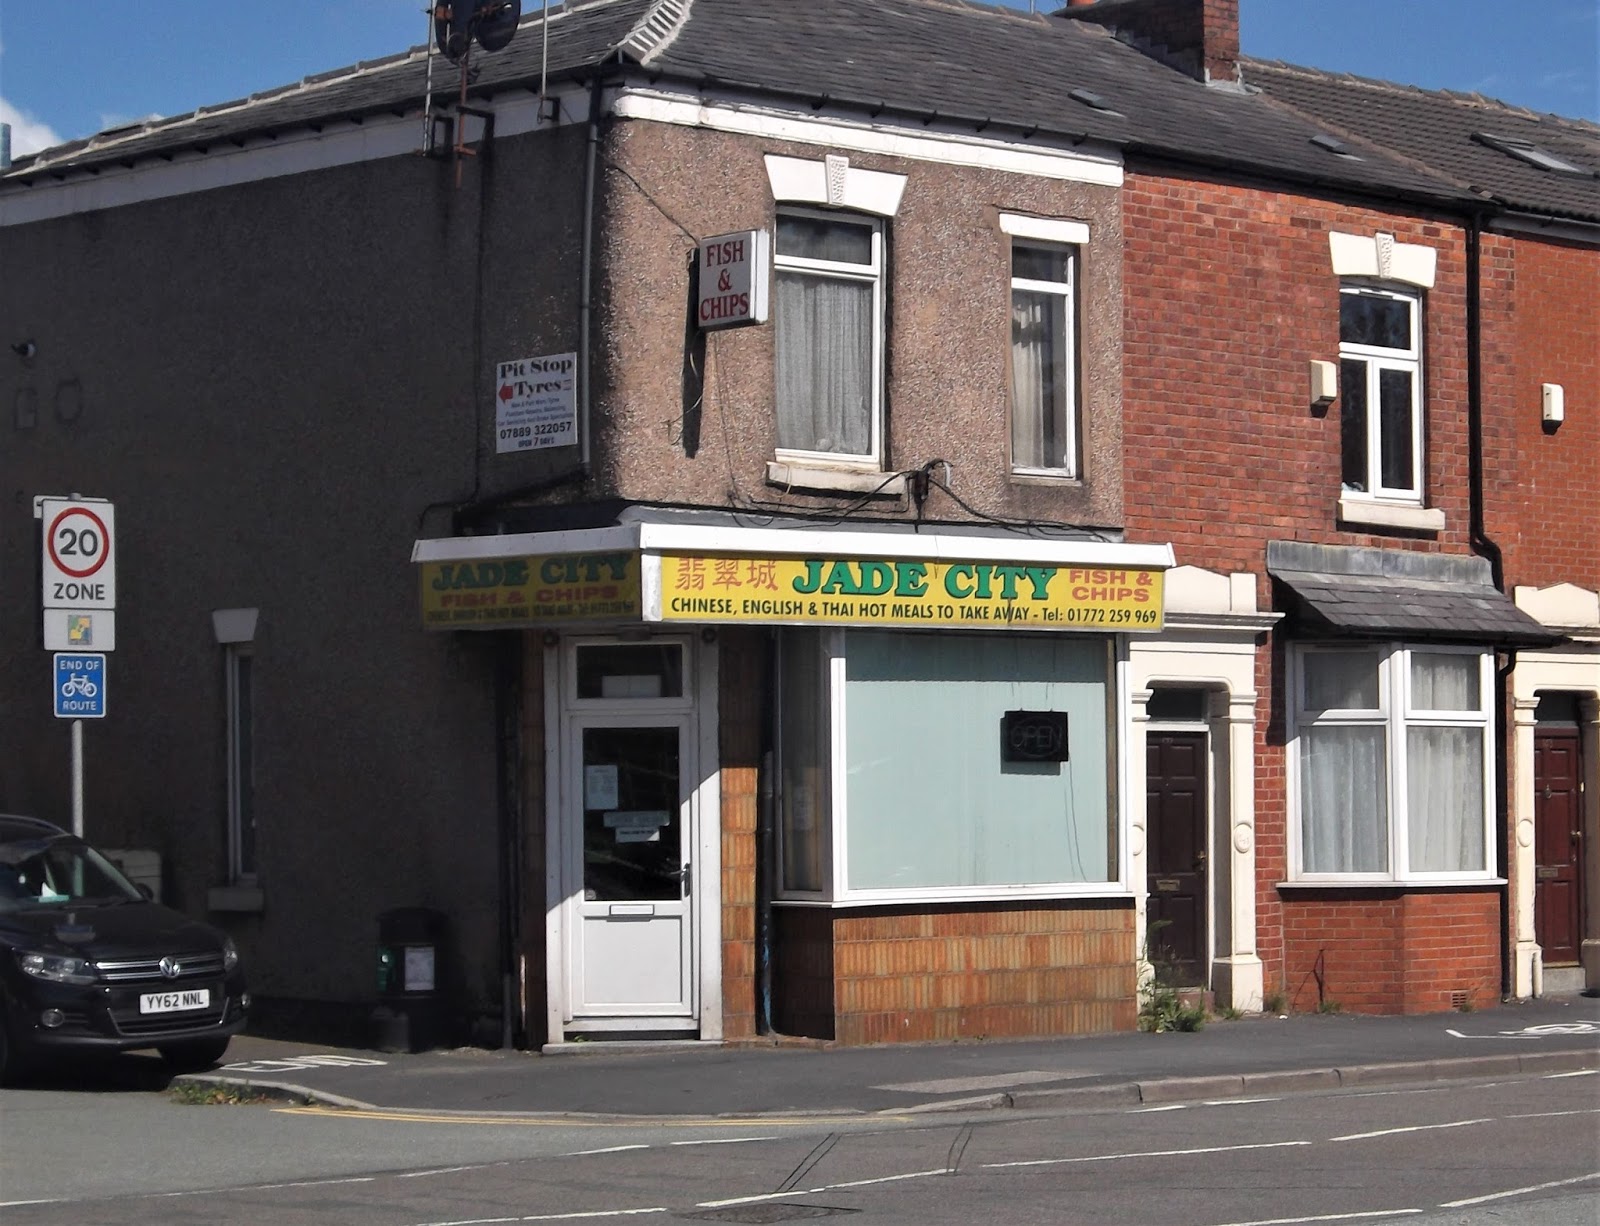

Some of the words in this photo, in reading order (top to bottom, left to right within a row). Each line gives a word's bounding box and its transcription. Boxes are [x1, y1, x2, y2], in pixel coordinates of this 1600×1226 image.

[706, 240, 744, 268] FISH
[717, 268, 732, 292] &
[700, 292, 749, 321] CHIPS
[500, 362, 525, 379] Pit
[530, 359, 572, 374] Stop
[514, 380, 562, 398] Tyres
[500, 426, 531, 440] 07889
[534, 421, 572, 436] 322057
[533, 437, 539, 447] 7
[58, 527, 98, 557] 20
[432, 559, 530, 591] JADE
[540, 552, 634, 584] CITY
[675, 557, 779, 591] 翡翠城
[792, 559, 930, 598] JADE
[944, 563, 1058, 601] CITY
[1069, 569, 1126, 585] FISH
[1136, 571, 1153, 586] &
[53, 583, 105, 600] ZONE
[441, 591, 498, 608] FISH
[507, 590, 524, 604] &
[536, 585, 619, 603] CHIPS
[1071, 586, 1150, 603] CHIPS
[671, 597, 737, 615] CHINESE,
[742, 600, 802, 615] ENGLISH
[808, 601, 818, 616] &
[822, 602, 854, 616] THAI
[859, 603, 886, 618] HOT
[891, 604, 933, 619] MEALS
[938, 605, 954, 619] TO
[960, 605, 989, 620] TAKE
[993, 606, 1029, 622] AWAY
[1042, 607, 1063, 621] Tel:
[1067, 608, 1105, 622] 01772
[1109, 609, 1130, 623] 259
[1135, 610, 1157, 624] 969
[60, 660, 83, 670] END
[85, 660, 100, 670] OF
[62, 700, 97, 711] ROUTE
[147, 993, 180, 1009] YY62
[182, 992, 204, 1007] NNL
